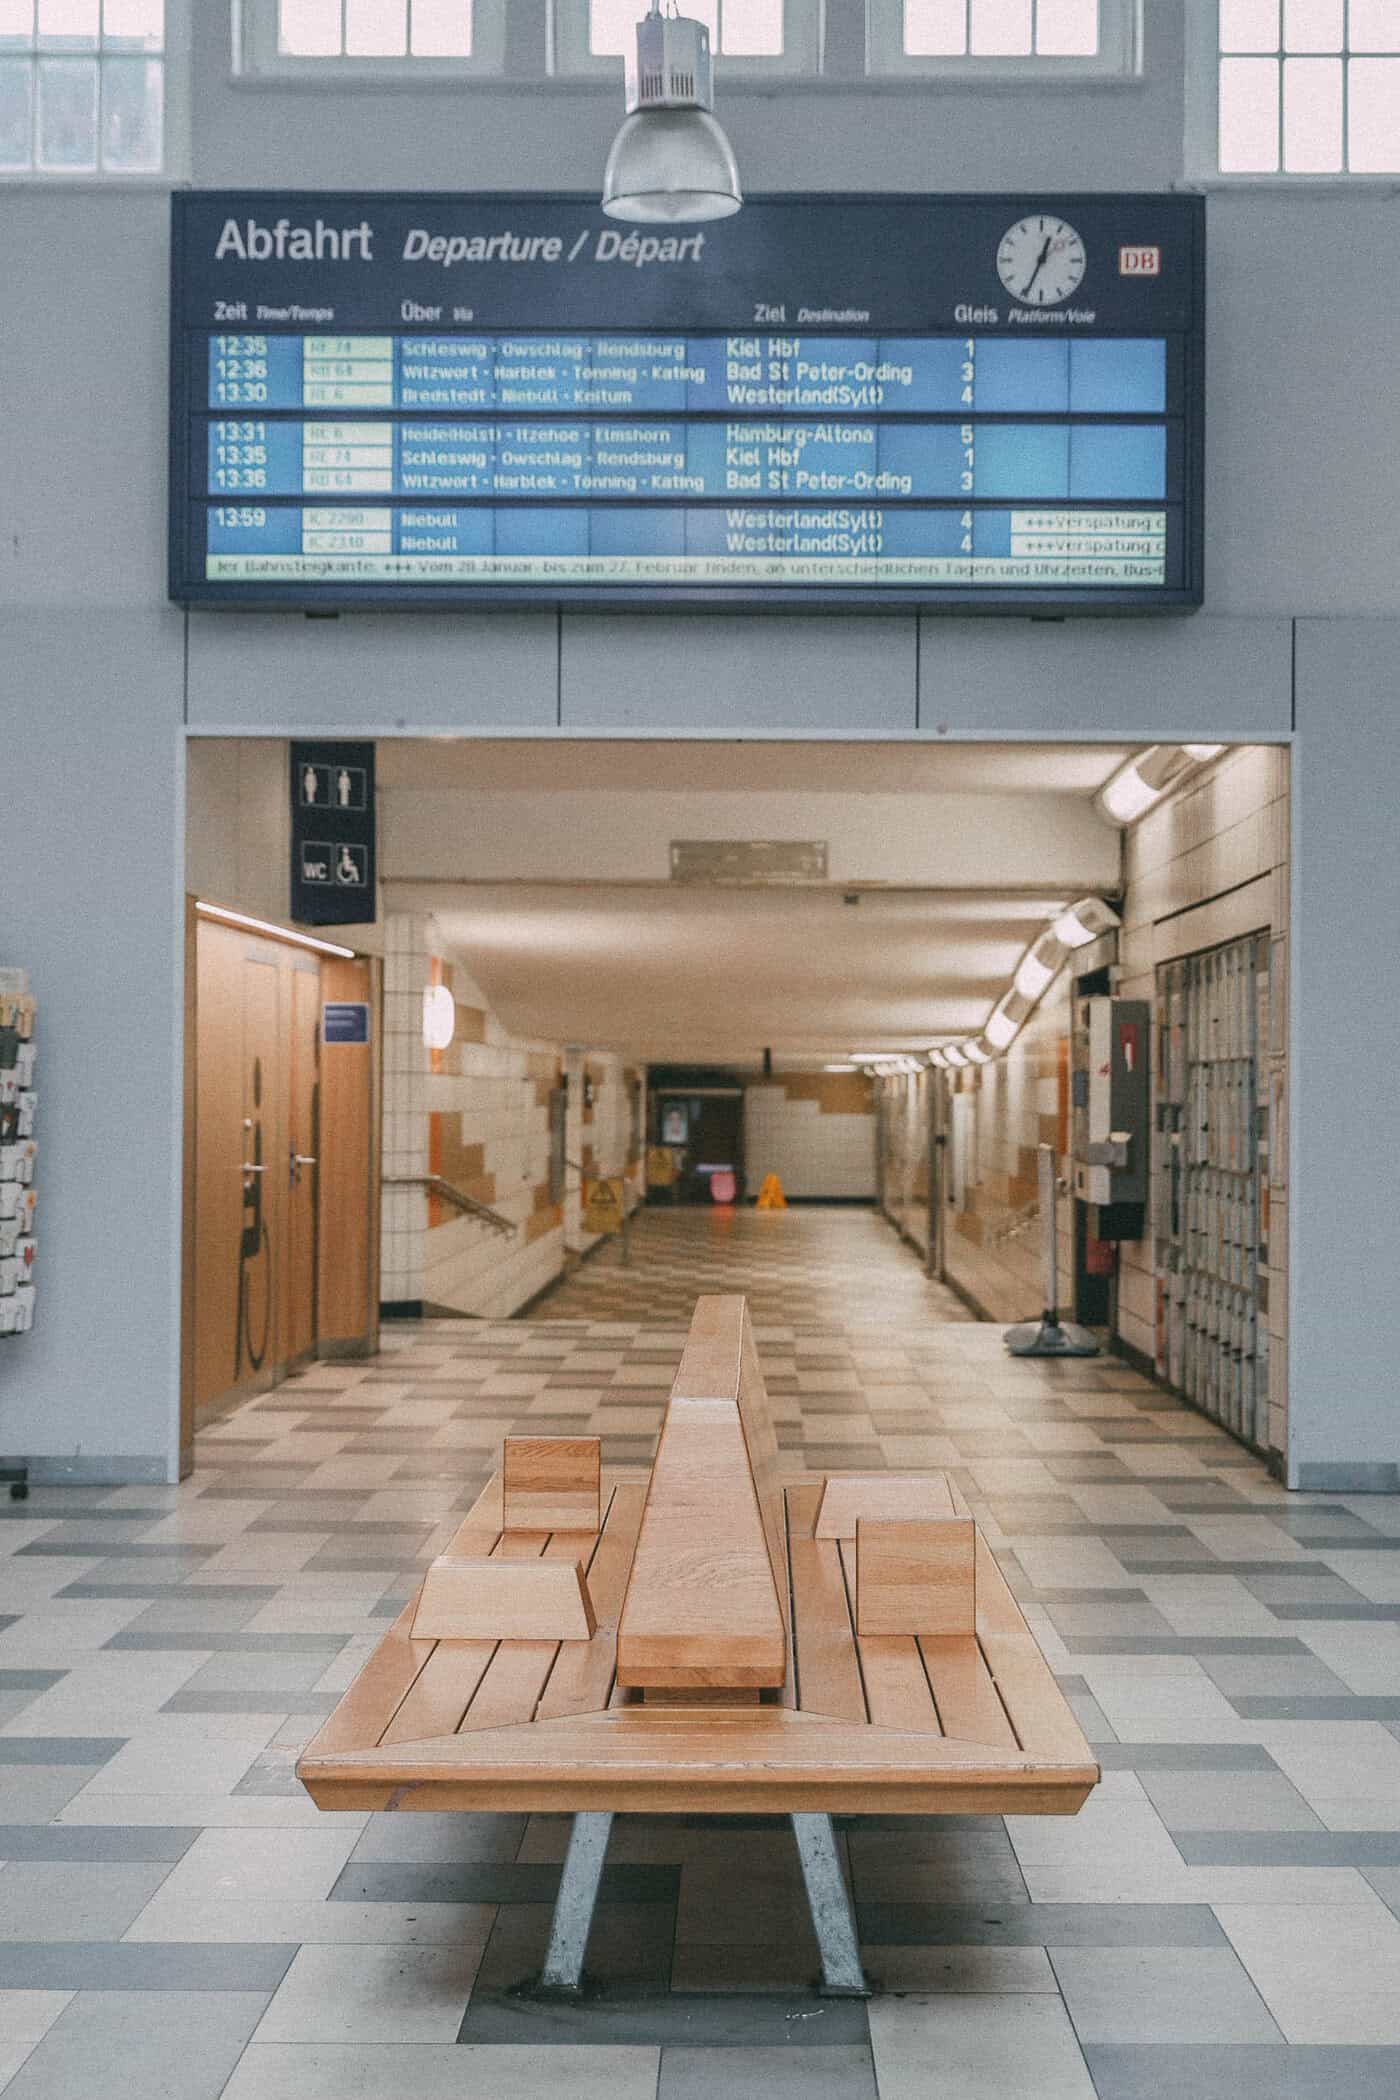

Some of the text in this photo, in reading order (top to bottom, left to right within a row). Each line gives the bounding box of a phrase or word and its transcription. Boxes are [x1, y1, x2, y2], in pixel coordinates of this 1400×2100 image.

[215, 219, 705, 266] Abfahrt Departure / Départ
[1122, 250, 1157, 271] DB
[214, 301, 334, 322] Zeit Time/Temps
[400, 299, 474, 321] Über Via
[754, 304, 870, 323] Ziel Destination
[954, 304, 1097, 324] Gleis Platform/Voie
[726, 337, 800, 357] Kiel Hbf
[964, 338, 975, 357] 1
[726, 362, 913, 385] Bad St Peter-Ording
[961, 362, 974, 382] 3
[216, 382, 268, 402] 13:30
[727, 385, 884, 408] Westerland(Sylt)
[961, 386, 974, 405] 4
[216, 422, 266, 441] 13:31
[516, 427, 580, 443] Itzehoe
[595, 427, 671, 443] Elmshorn
[726, 424, 874, 447] Hamburg-Altona
[960, 424, 973, 444] 5
[216, 445, 267, 465] 13:35
[402, 451, 685, 469] Schleswig Owschlag Rendsburg
[726, 447, 800, 466] Kiel Hbf
[964, 448, 975, 467] 1
[216, 468, 267, 488] 13:36
[650, 475, 705, 493] Kating
[726, 472, 912, 494] Bad St Peter-Ording
[961, 472, 974, 490] 3
[215, 507, 266, 528] 13:59
[726, 510, 884, 533] Westerland(Sylt)
[960, 511, 973, 529] 4
[726, 533, 884, 556] Westerland(Sylt)
[960, 534, 973, 552] 4
[999, 563, 1029, 576] und
[304, 862, 327, 879] WC
